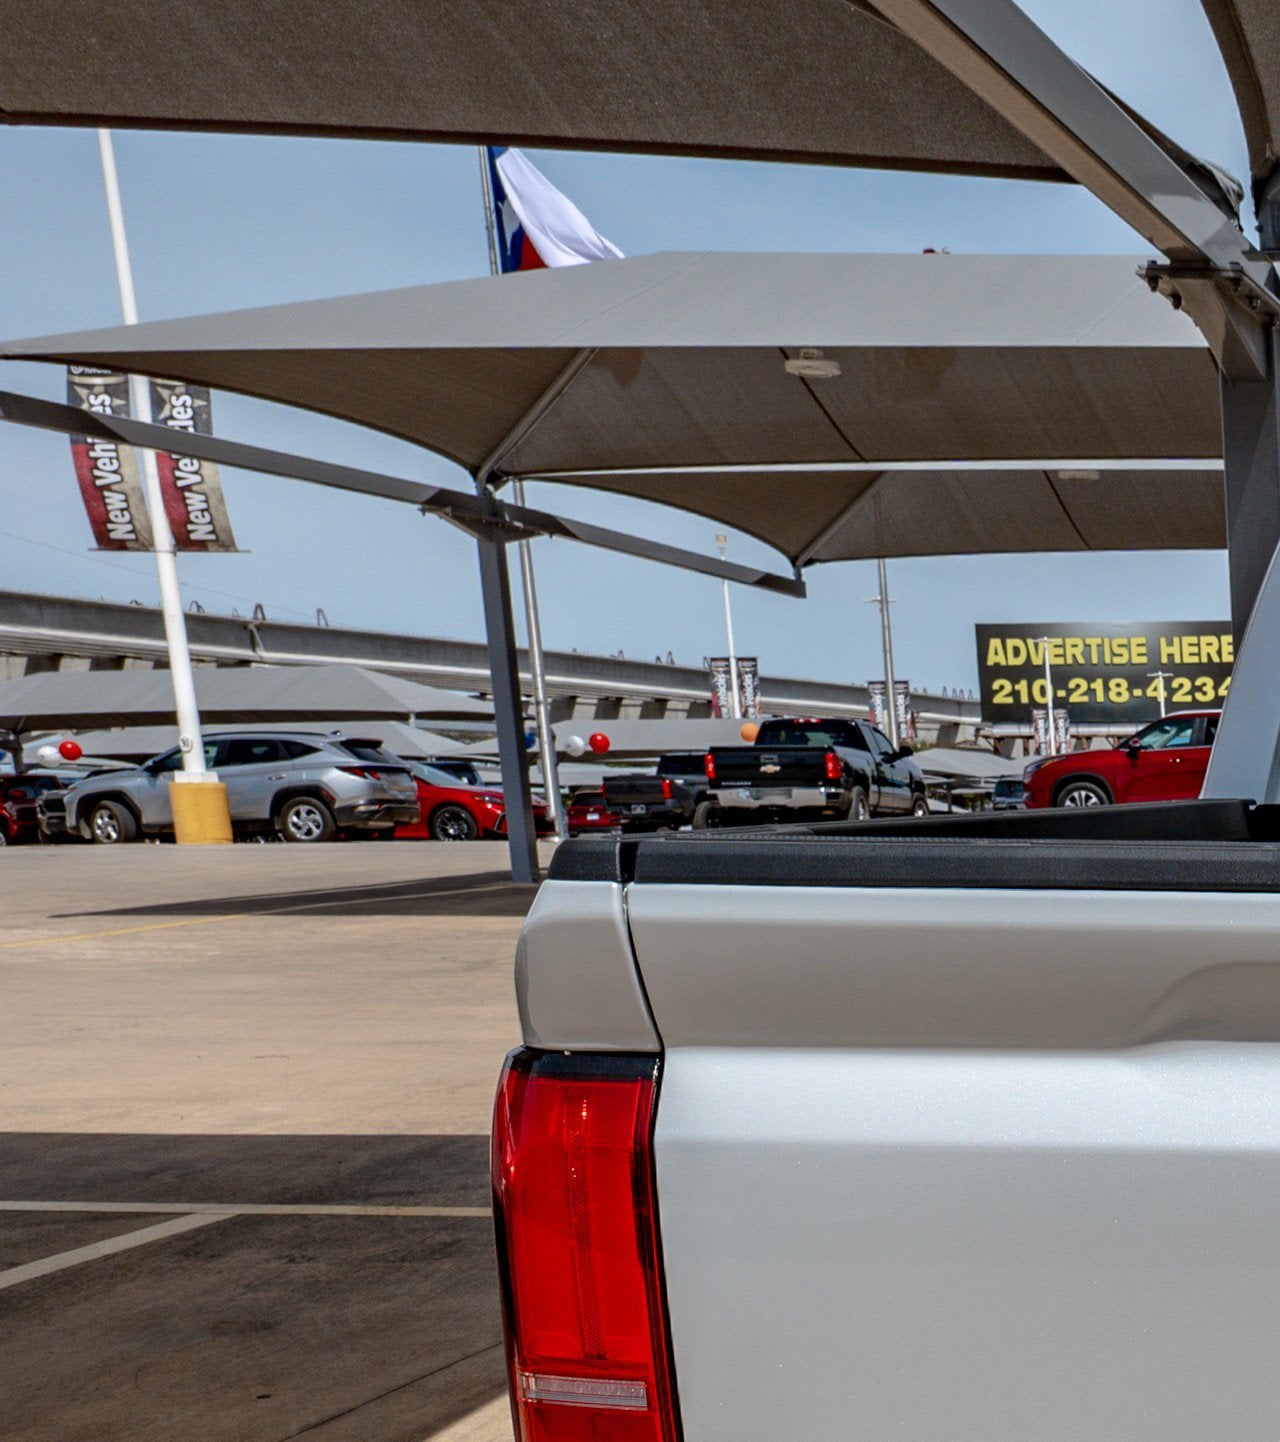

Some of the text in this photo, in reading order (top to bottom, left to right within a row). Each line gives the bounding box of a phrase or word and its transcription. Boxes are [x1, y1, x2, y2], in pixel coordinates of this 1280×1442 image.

[86, 393, 122, 487] Vehies
[167, 394, 217, 541] New Veles
[103, 490, 136, 541] New
[986, 634, 1234, 666] ADVERTISE HERE
